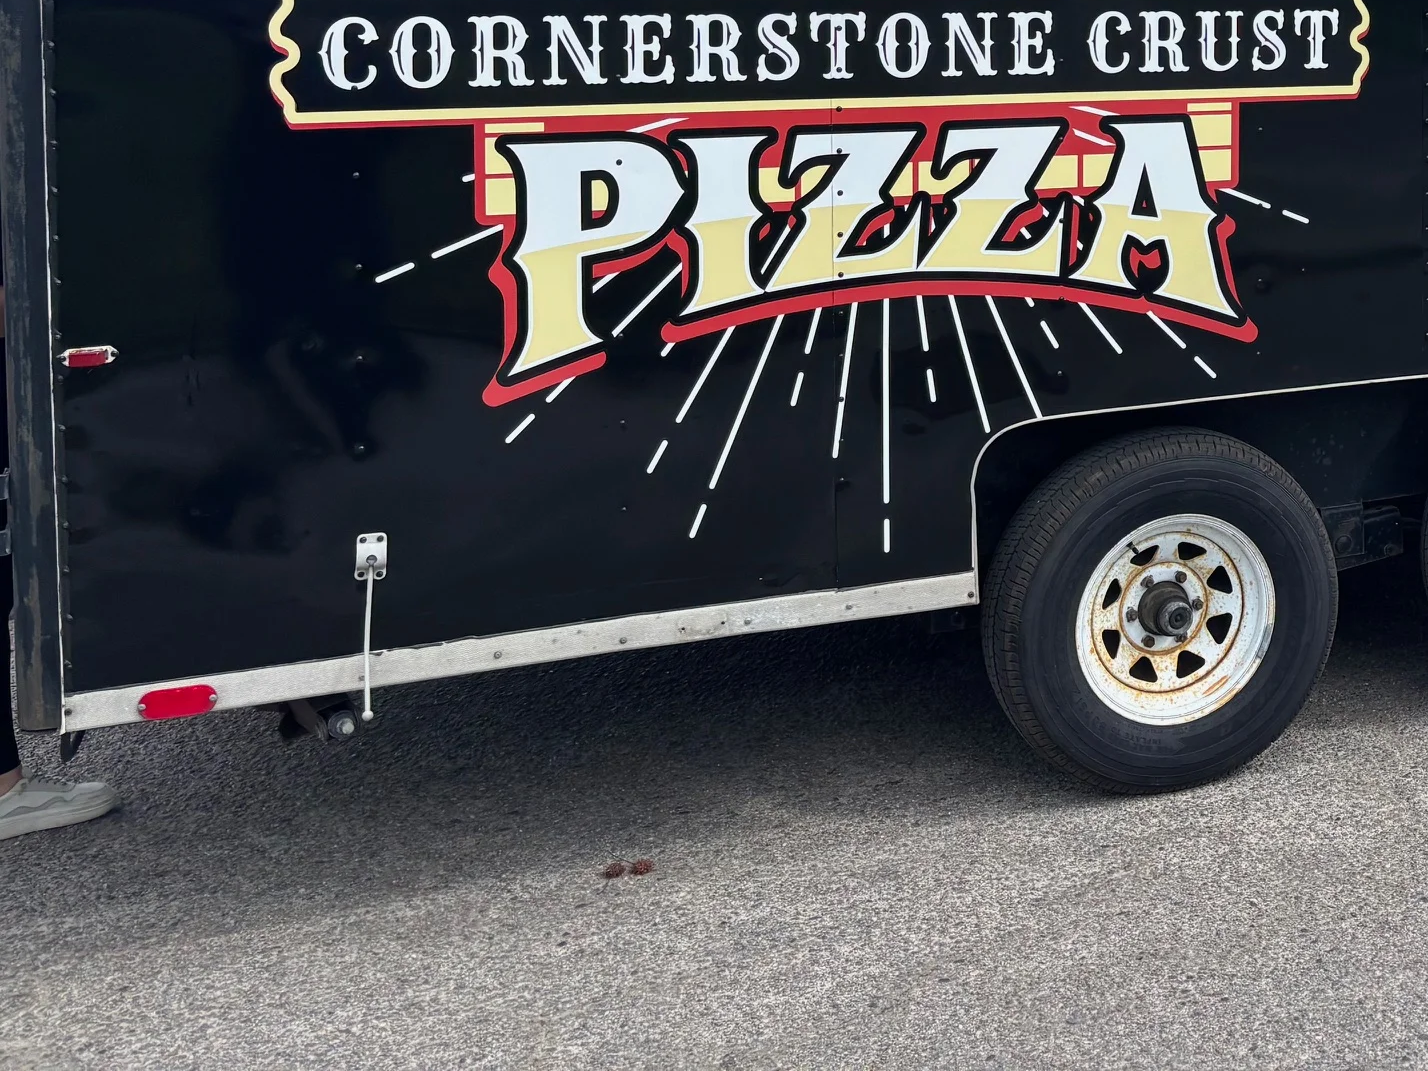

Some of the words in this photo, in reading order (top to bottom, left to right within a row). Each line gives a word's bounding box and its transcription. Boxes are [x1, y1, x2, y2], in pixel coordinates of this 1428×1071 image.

[317, 11, 1056, 90] CORNERSTONE
[1086, 8, 1339, 74] CRUST
[498, 117, 1245, 384] PIZZA
